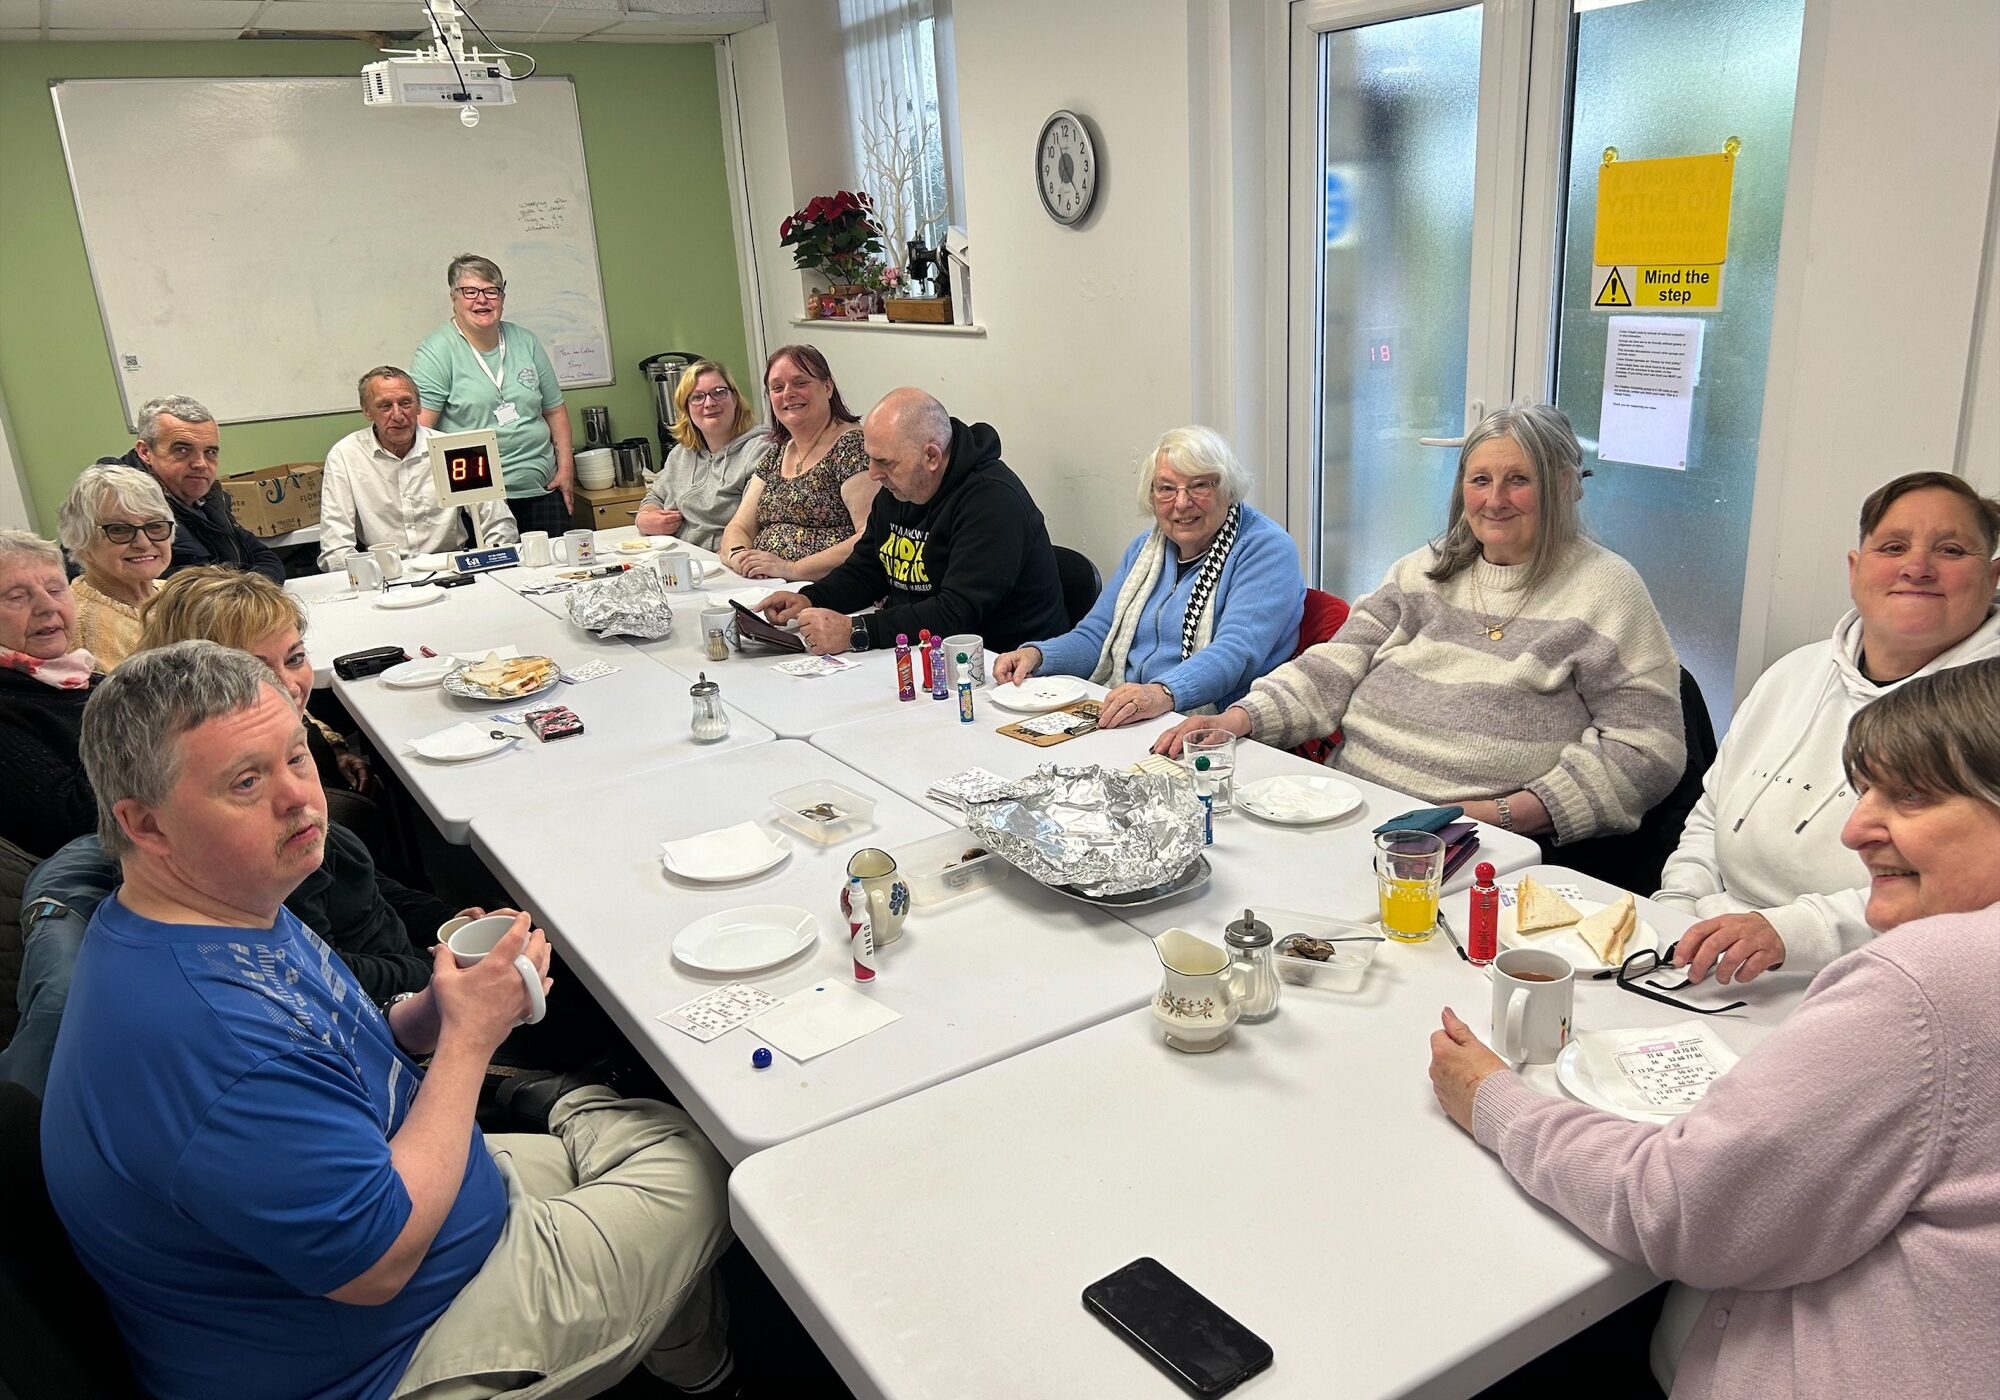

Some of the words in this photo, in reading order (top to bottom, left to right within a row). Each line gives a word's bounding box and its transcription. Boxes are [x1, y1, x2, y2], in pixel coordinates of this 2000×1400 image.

[1061, 125, 1068, 137] 12
[1073, 130, 1076, 141] 1
[1053, 133, 1059, 144] 11
[1048, 146, 1054, 158] 10
[1080, 142, 1085, 154] 2
[1045, 165, 1050, 176] 9
[1084, 161, 1088, 172] 3
[1050, 183, 1053, 194] 8
[1082, 179, 1086, 191] 4
[1058, 195, 1061, 205] 7
[1075, 193, 1080, 204] 5
[1067, 199, 1071, 210] 6
[1645, 271, 1680, 284] Mind
[1686, 270, 1709, 283] the
[1659, 288, 1691, 304] step
[453, 456, 483, 480] 81
[864, 924, 873, 956] BINGO
